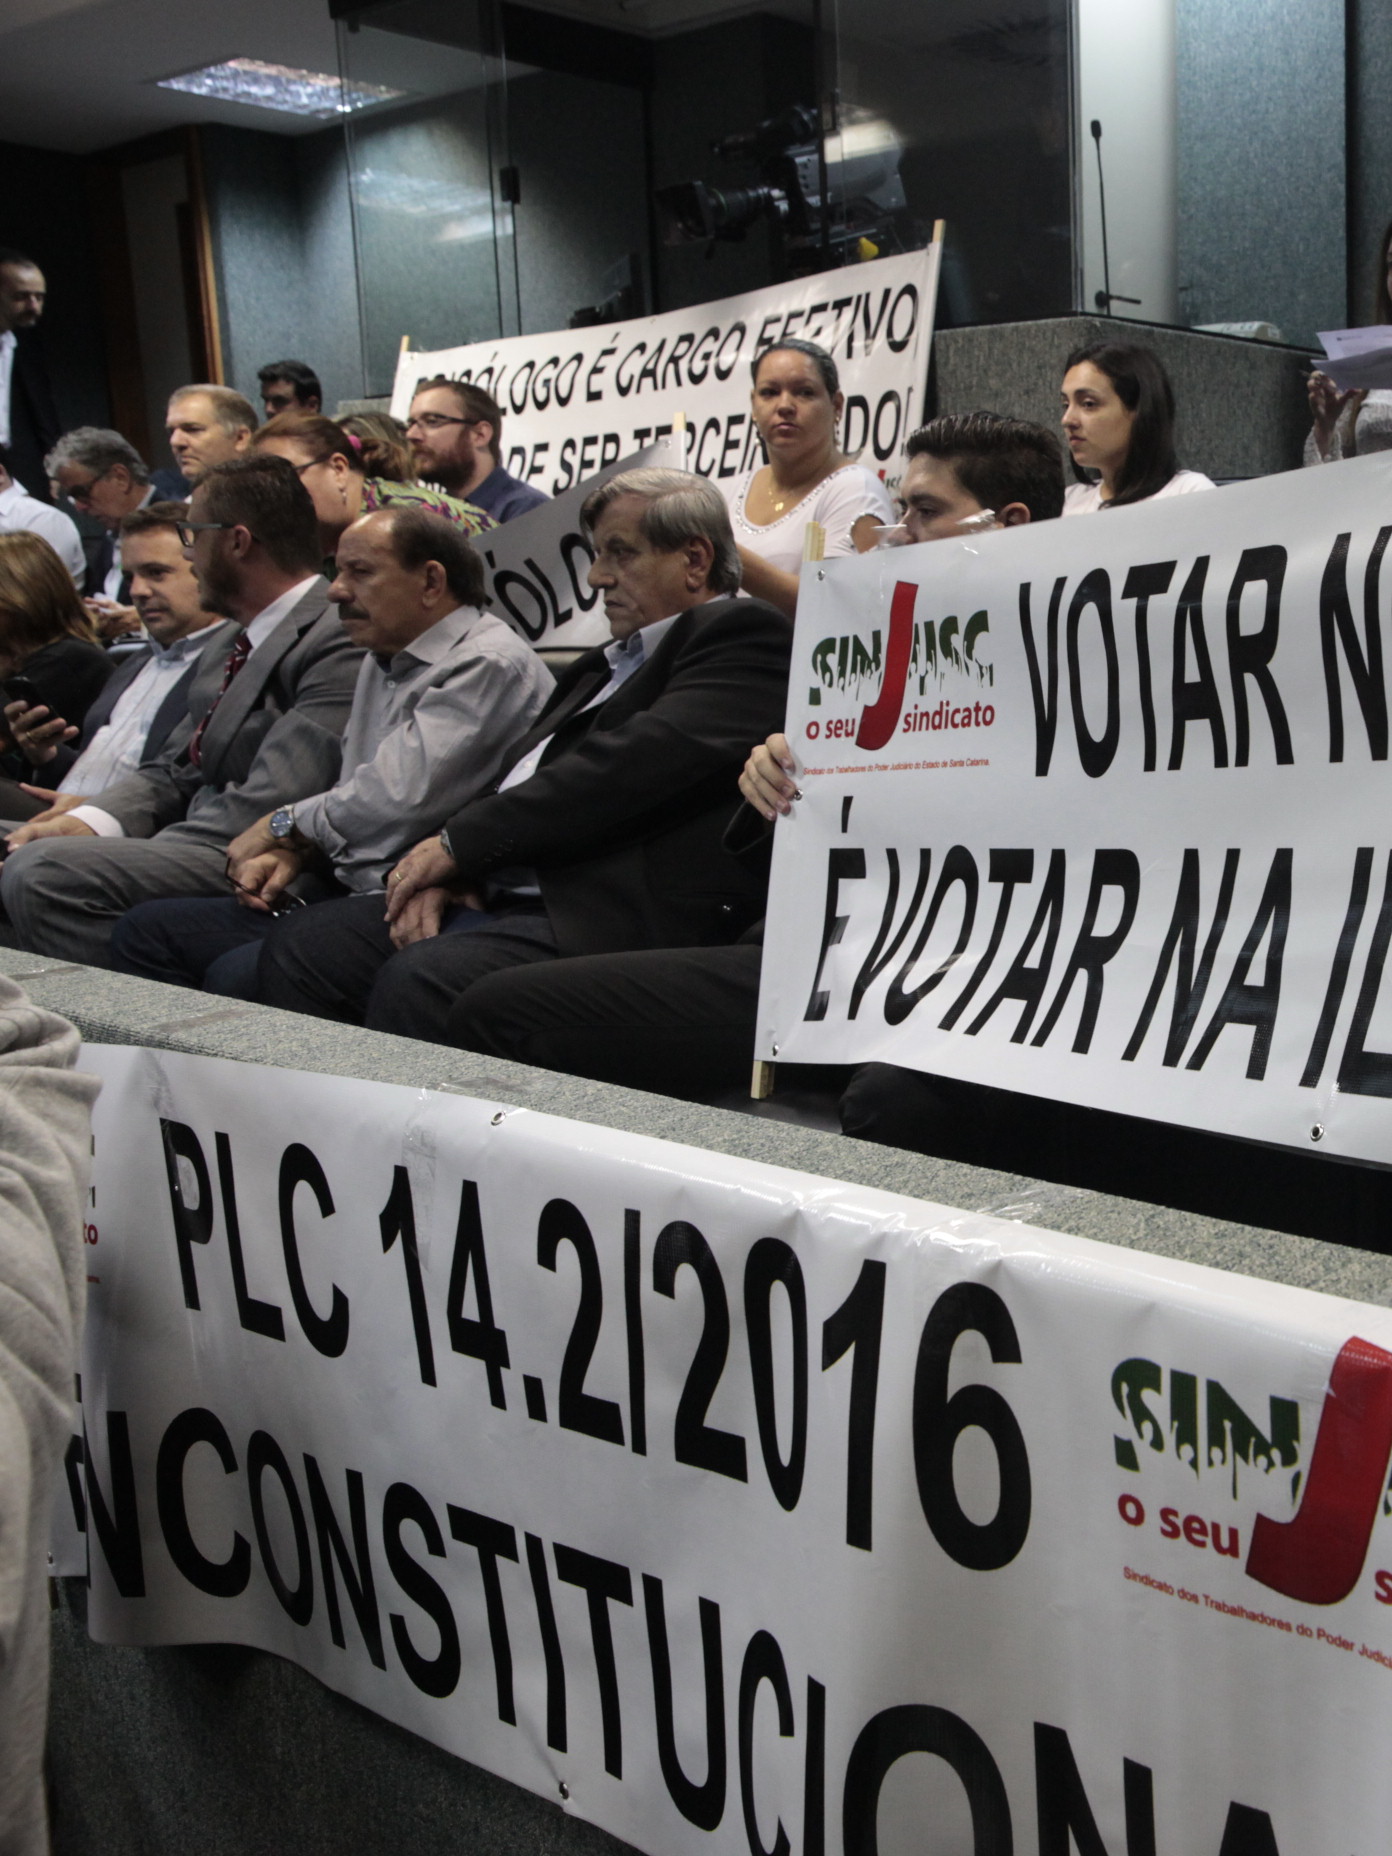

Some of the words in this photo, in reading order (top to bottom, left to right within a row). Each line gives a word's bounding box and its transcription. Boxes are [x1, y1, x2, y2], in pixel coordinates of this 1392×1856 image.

[412, 350, 584, 416] ÓLOGO
[586, 332, 621, 402] É
[615, 321, 747, 398] CARGO
[507, 442, 549, 483] DE
[552, 432, 620, 496] SER
[480, 532, 599, 642] ÓLO
[808, 580, 994, 751] SINJUSC
[1018, 545, 1295, 778] VOTAR
[806, 721, 820, 740] o
[825, 718, 856, 739] seu
[902, 700, 995, 733] sindicato
[875, 763, 889, 772] Poder
[922, 760, 940, 769] Estado
[949, 758, 964, 767] Santa
[803, 796, 867, 1022] É
[848, 844, 1141, 1055] VOTAR
[1121, 847, 1294, 1081] NA
[159, 1117, 350, 1358] PLC
[379, 1164, 1032, 1572] 14.2/2016
[1117, 1494, 1145, 1526] o
[1159, 1507, 1240, 1559] seu
[1122, 1565, 1175, 1597] Sindicato
[1177, 1586, 1200, 1605] dos
[1202, 1594, 1292, 1632] Trabalhadores
[1296, 1622, 1313, 1640] do
[1316, 1626, 1355, 1652] Poder
